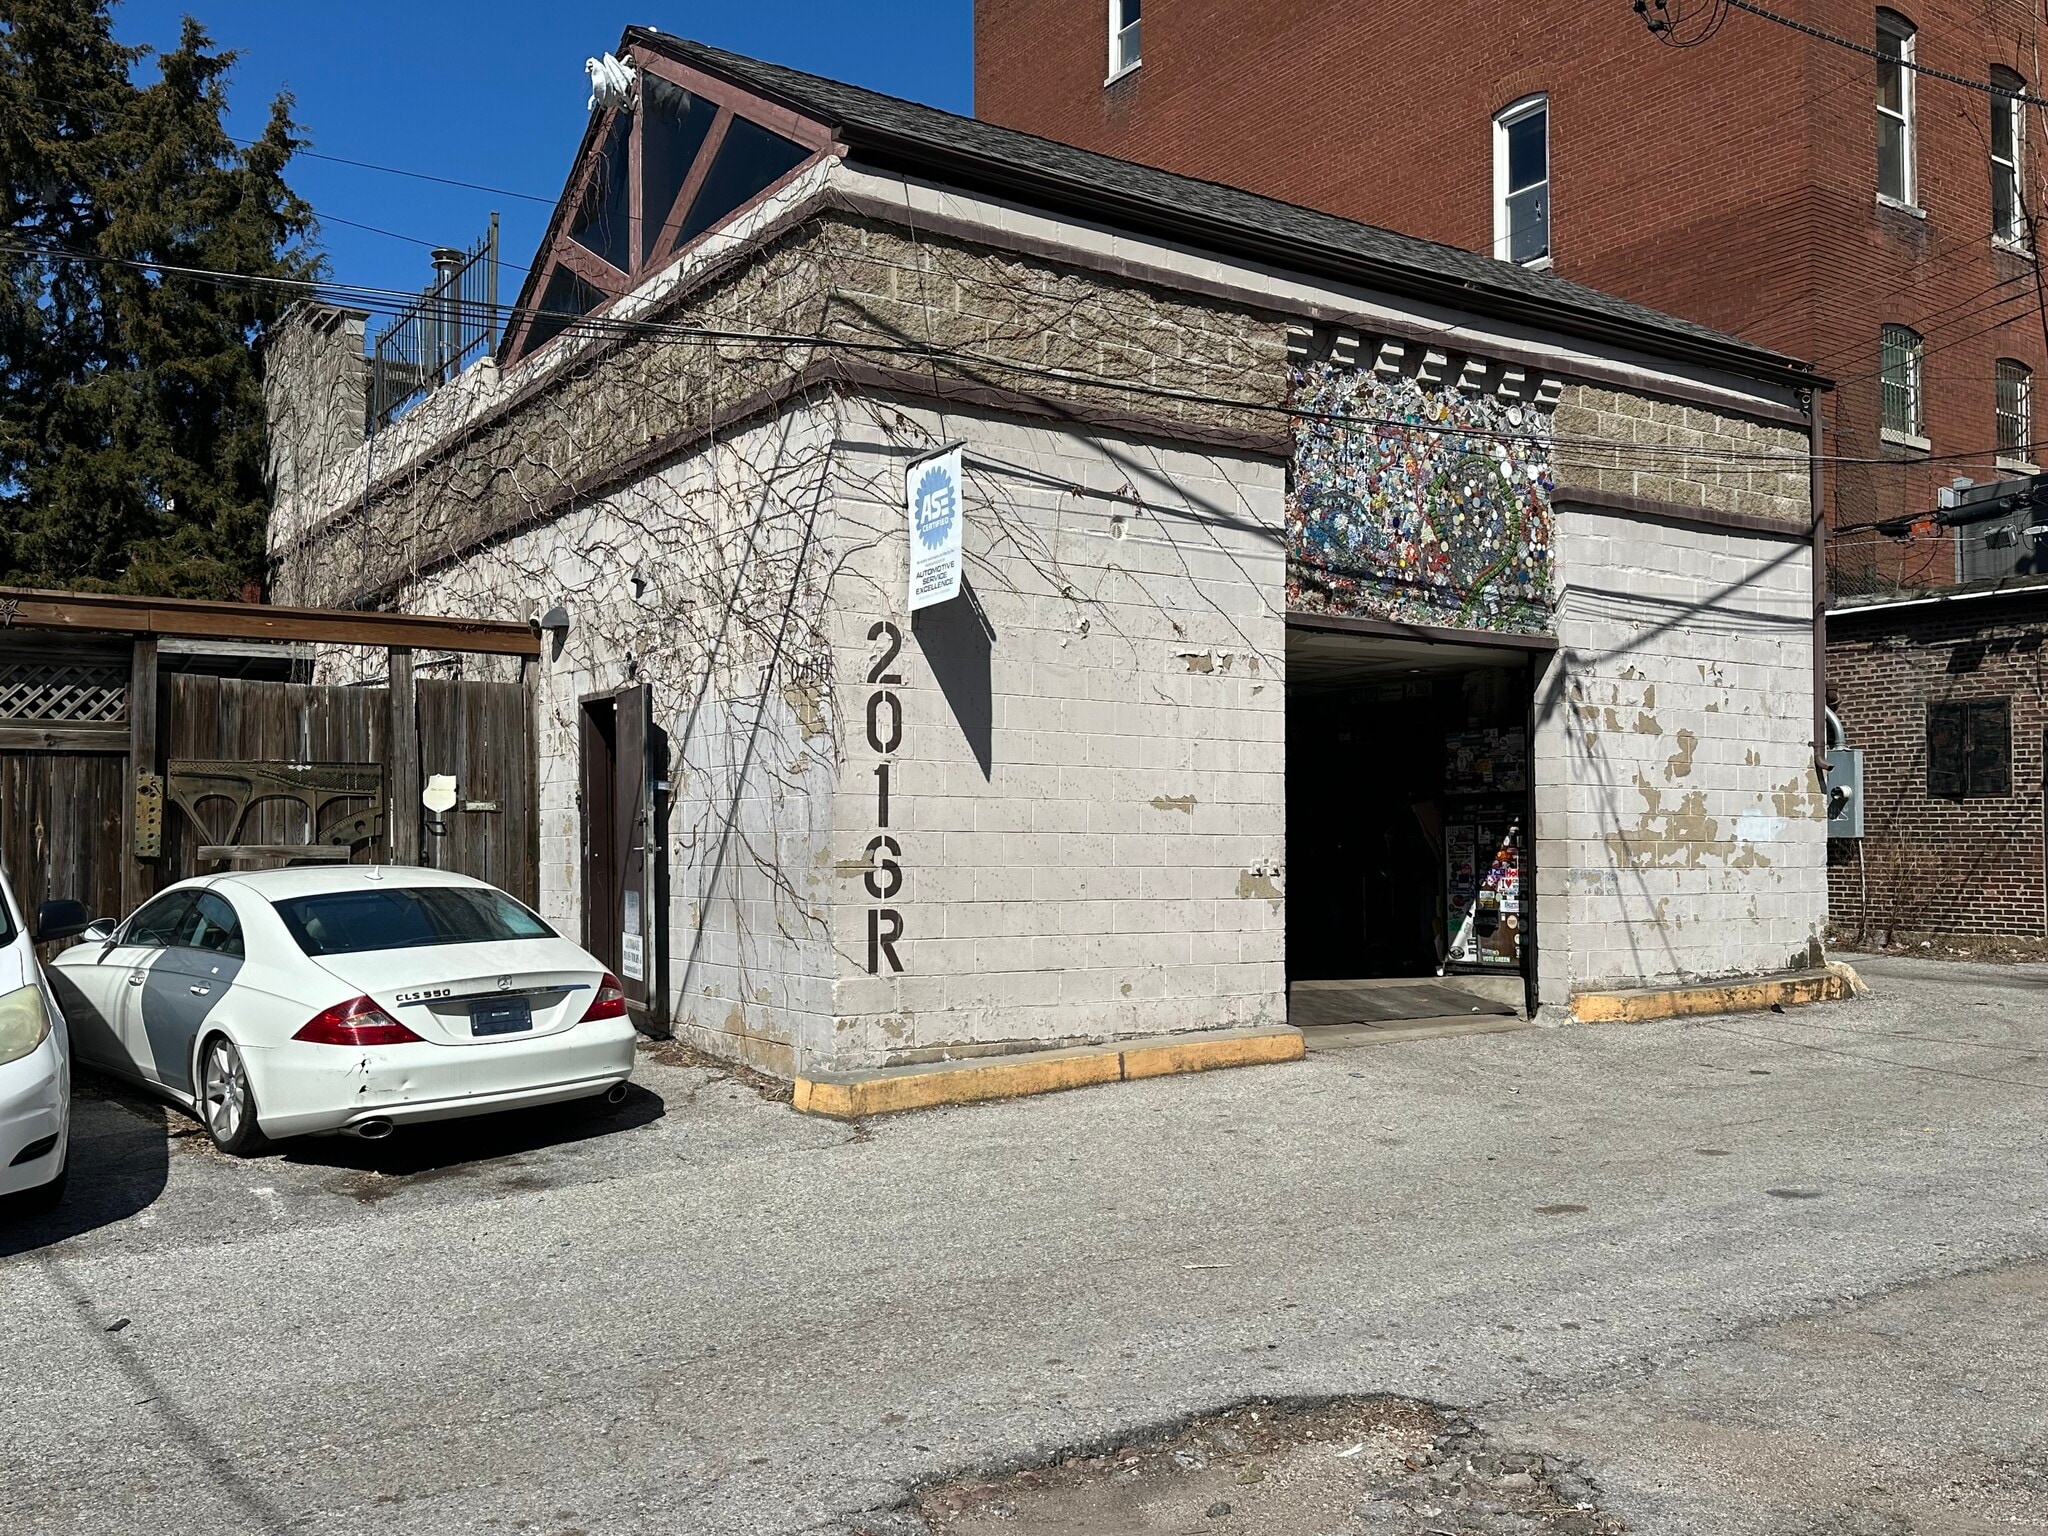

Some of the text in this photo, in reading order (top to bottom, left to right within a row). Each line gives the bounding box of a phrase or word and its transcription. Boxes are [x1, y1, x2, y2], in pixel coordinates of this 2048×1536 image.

[920, 487, 949, 525] ASE
[922, 518, 949, 533] CERTIFIED
[916, 560, 955, 579] AUTOMOTIVE
[922, 571, 948, 585] SERVICE
[915, 577, 954, 595] EXCELLENCE
[864, 620, 904, 974] 2016R
[396, 988, 451, 1001] CLS 550
